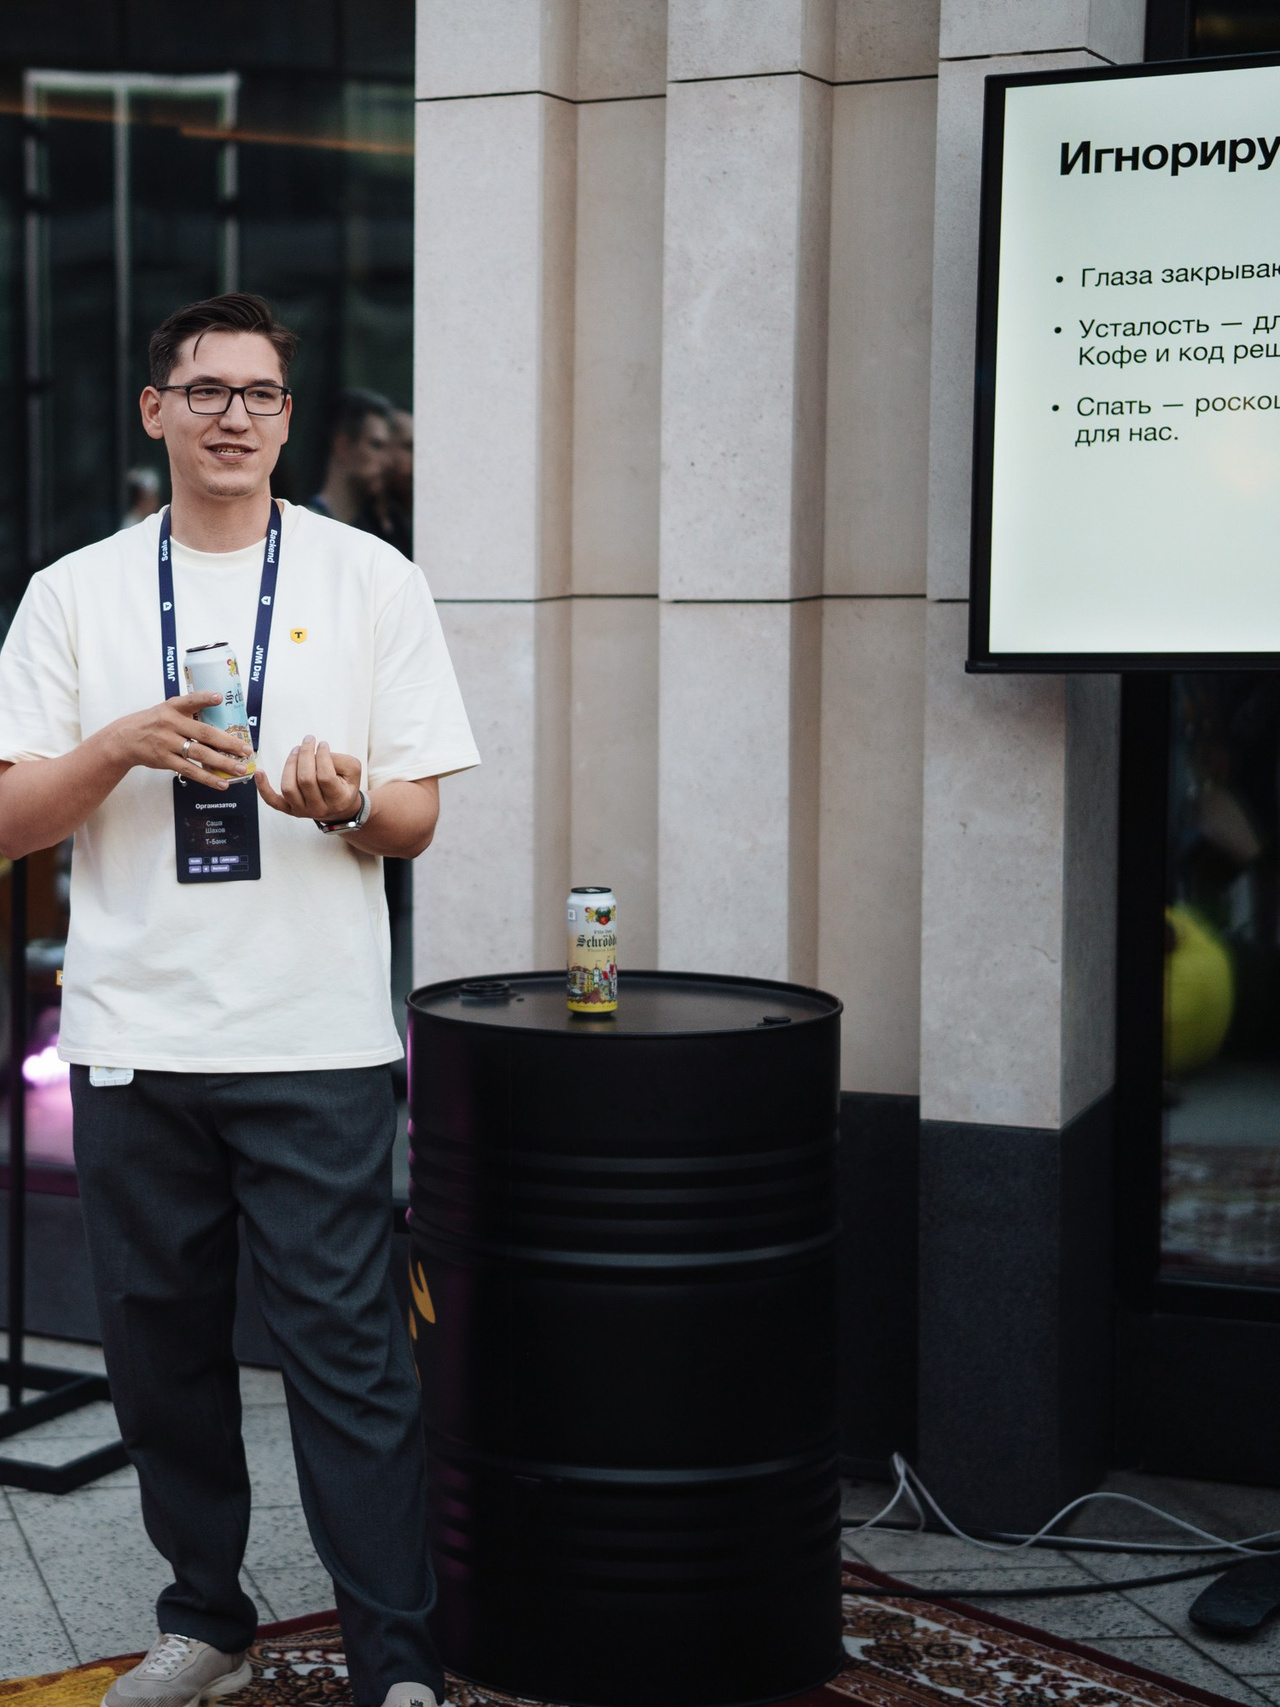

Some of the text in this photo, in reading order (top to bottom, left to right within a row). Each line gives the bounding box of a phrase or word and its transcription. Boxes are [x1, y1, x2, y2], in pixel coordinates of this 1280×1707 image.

[1060, 136, 1280, 177] Игнориру
[1081, 268, 1153, 287] Глаза
[1079, 319, 1210, 339] Усталость
[1079, 345, 1147, 369] Кофе
[1156, 348, 1170, 362] и
[1179, 345, 1224, 364] код
[1077, 397, 1151, 416] Спать
[1075, 426, 1179, 447] для нас.
[267, 529, 278, 563] Backend
[166, 646, 176, 682] JVM Day
[250, 645, 264, 682] JVM Day
[195, 802, 237, 810] Организатор
